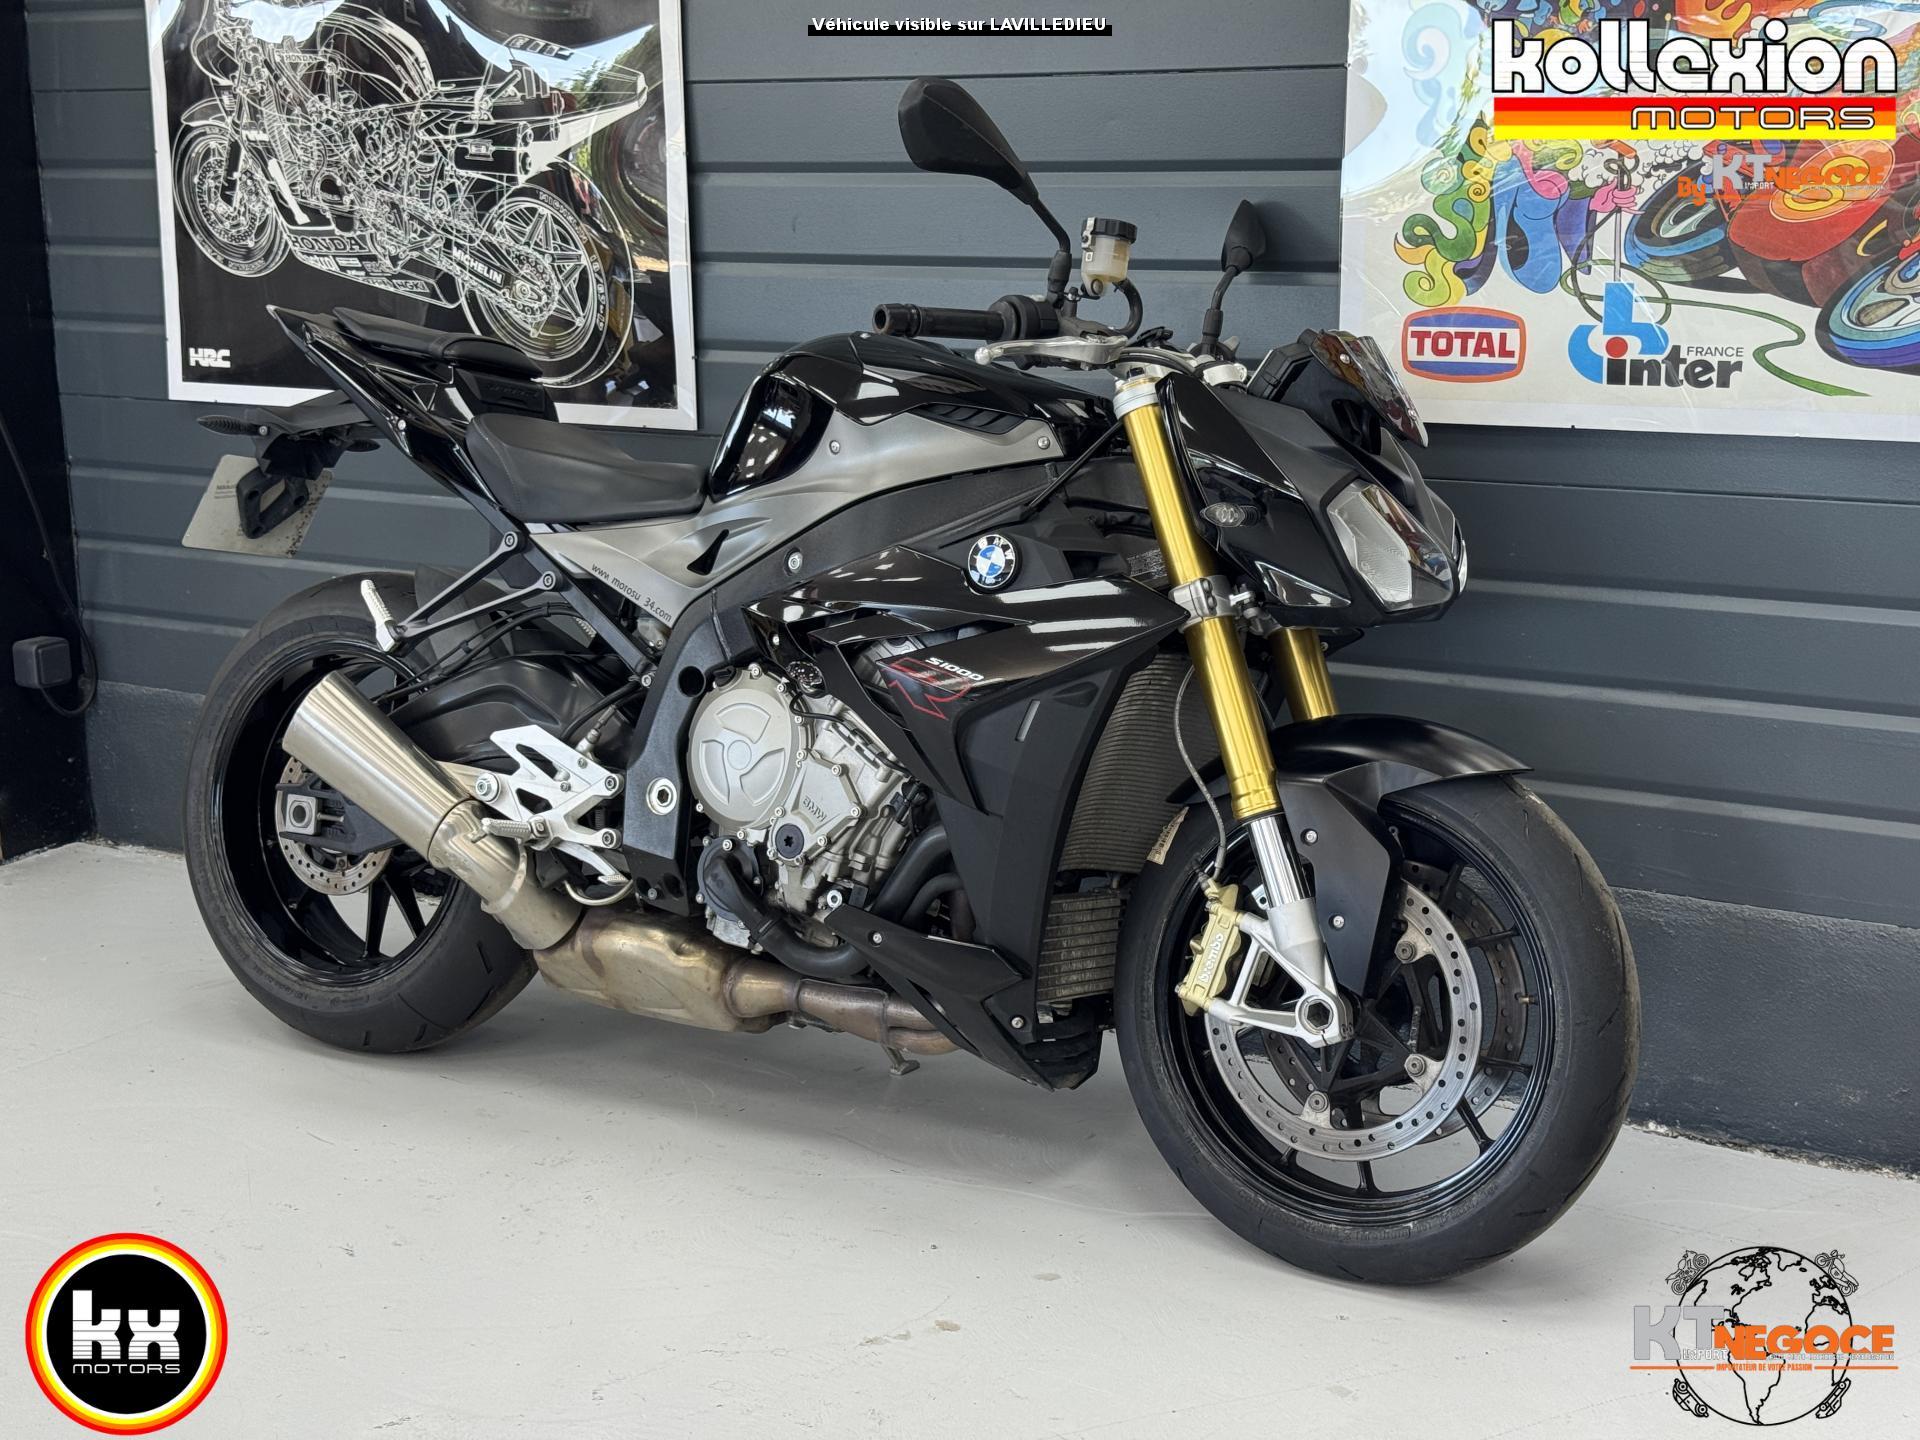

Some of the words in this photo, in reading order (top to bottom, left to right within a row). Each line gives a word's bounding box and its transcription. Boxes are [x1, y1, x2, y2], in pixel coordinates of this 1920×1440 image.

[291, 235, 369, 252] HONDA
[452, 246, 503, 285] MICHELIN
[188, 347, 231, 369] HRC
[1410, 330, 1516, 359] TOTAL
[1686, 345, 1744, 358] FRANCE
[1605, 336, 1744, 389] inter
[803, 795, 828, 822] BMW
[1198, 932, 1224, 983] brembo
